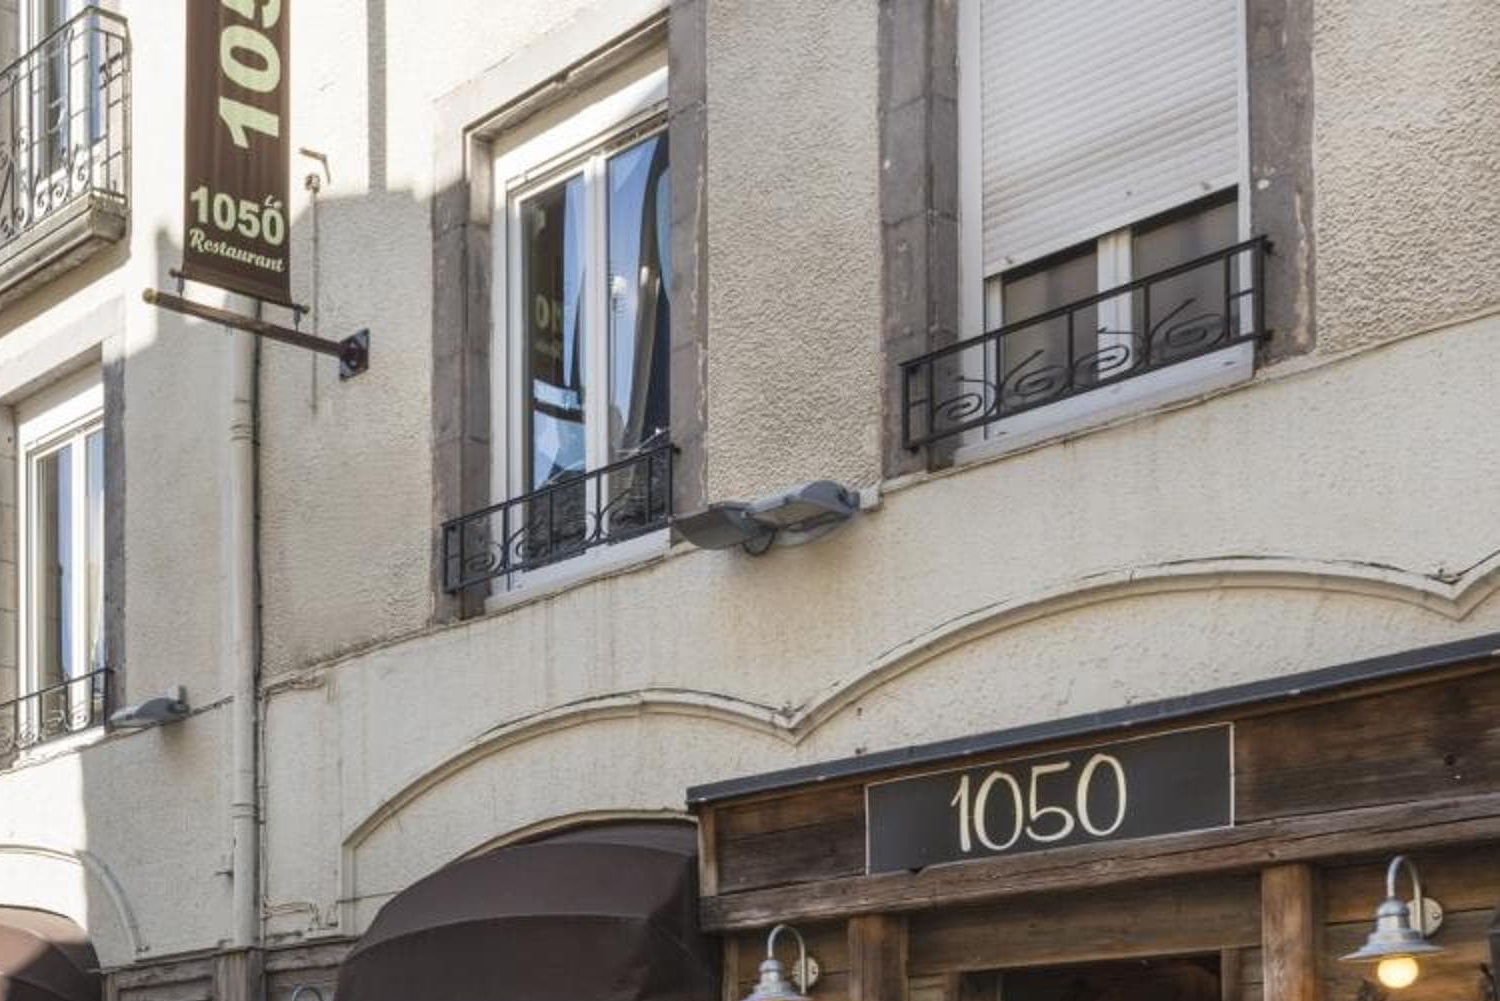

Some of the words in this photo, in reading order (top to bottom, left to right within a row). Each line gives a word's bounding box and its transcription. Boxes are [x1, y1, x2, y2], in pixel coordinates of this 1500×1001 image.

[189, 185, 285, 246] 1050
[188, 227, 286, 273] Restaurant
[950, 753, 1128, 853] 1050
